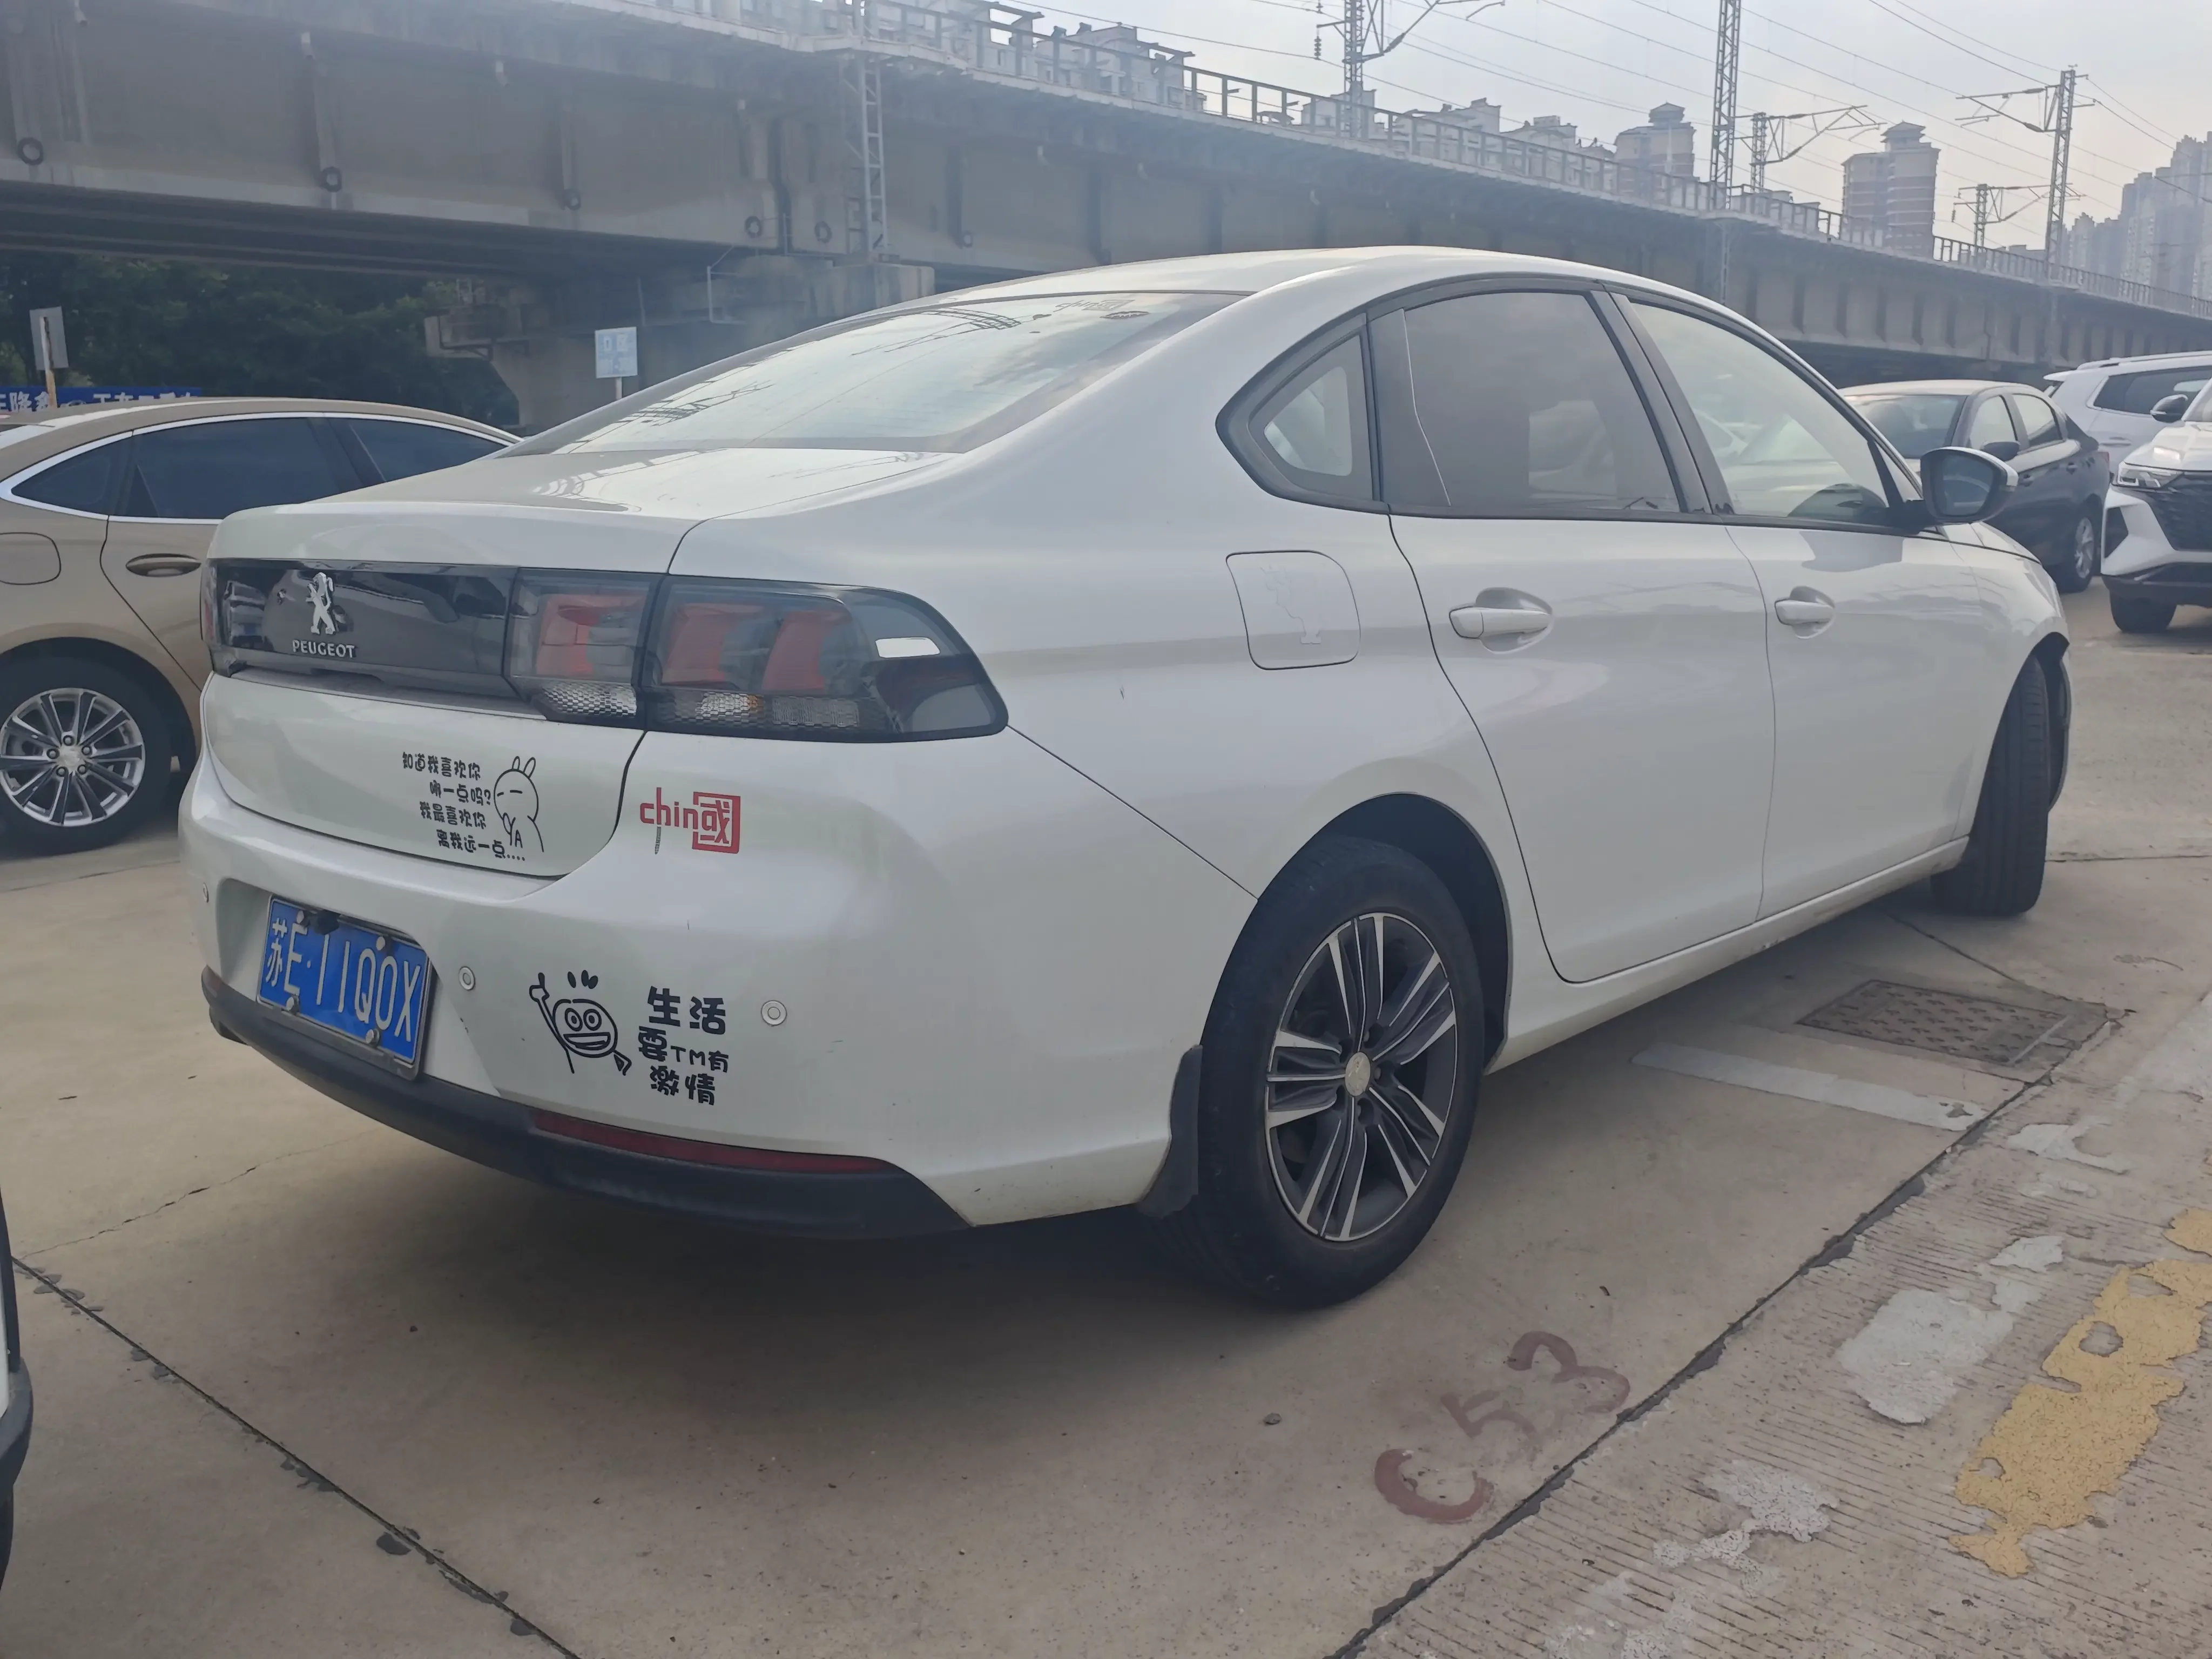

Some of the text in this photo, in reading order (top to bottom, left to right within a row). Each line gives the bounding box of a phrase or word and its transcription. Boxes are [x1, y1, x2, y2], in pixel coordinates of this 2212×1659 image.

[292, 639, 355, 658] PEUGEOT
[402, 751, 481, 781] 知道我喜欢你
[420, 801, 487, 830] 我最喜欢你
[648, 986, 726, 1035] 生活
[638, 1026, 729, 1073] 要TM有
[649, 1065, 716, 1106] 激情
